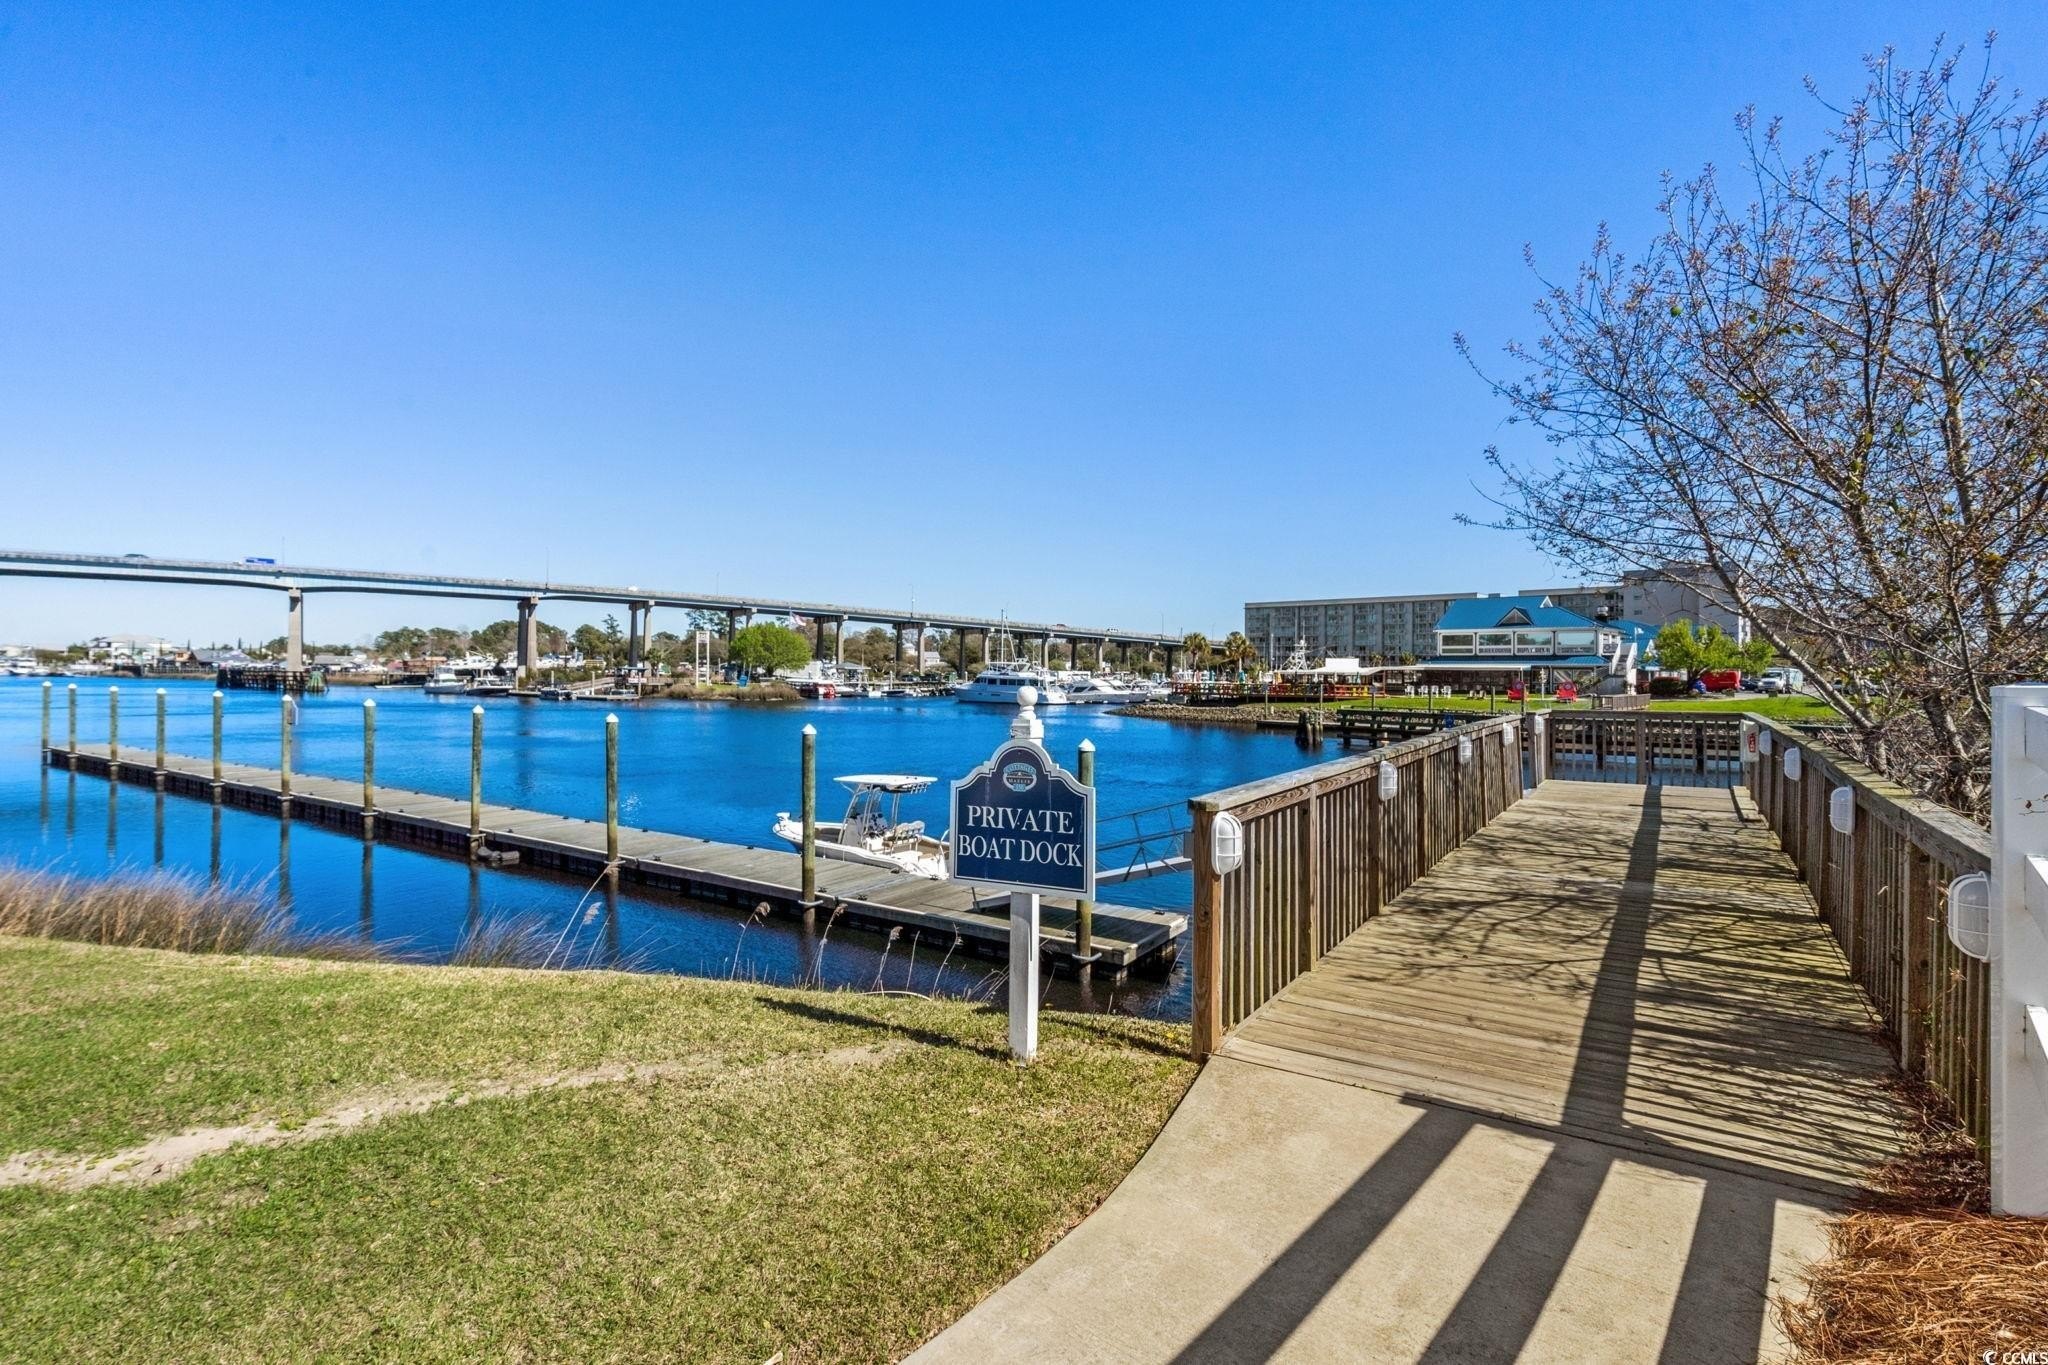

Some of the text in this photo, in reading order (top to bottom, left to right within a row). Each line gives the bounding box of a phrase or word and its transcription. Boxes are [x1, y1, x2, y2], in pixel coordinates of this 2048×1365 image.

[967, 805, 1074, 834] PRIVATE
[958, 834, 1083, 867] BOAT DOCK
